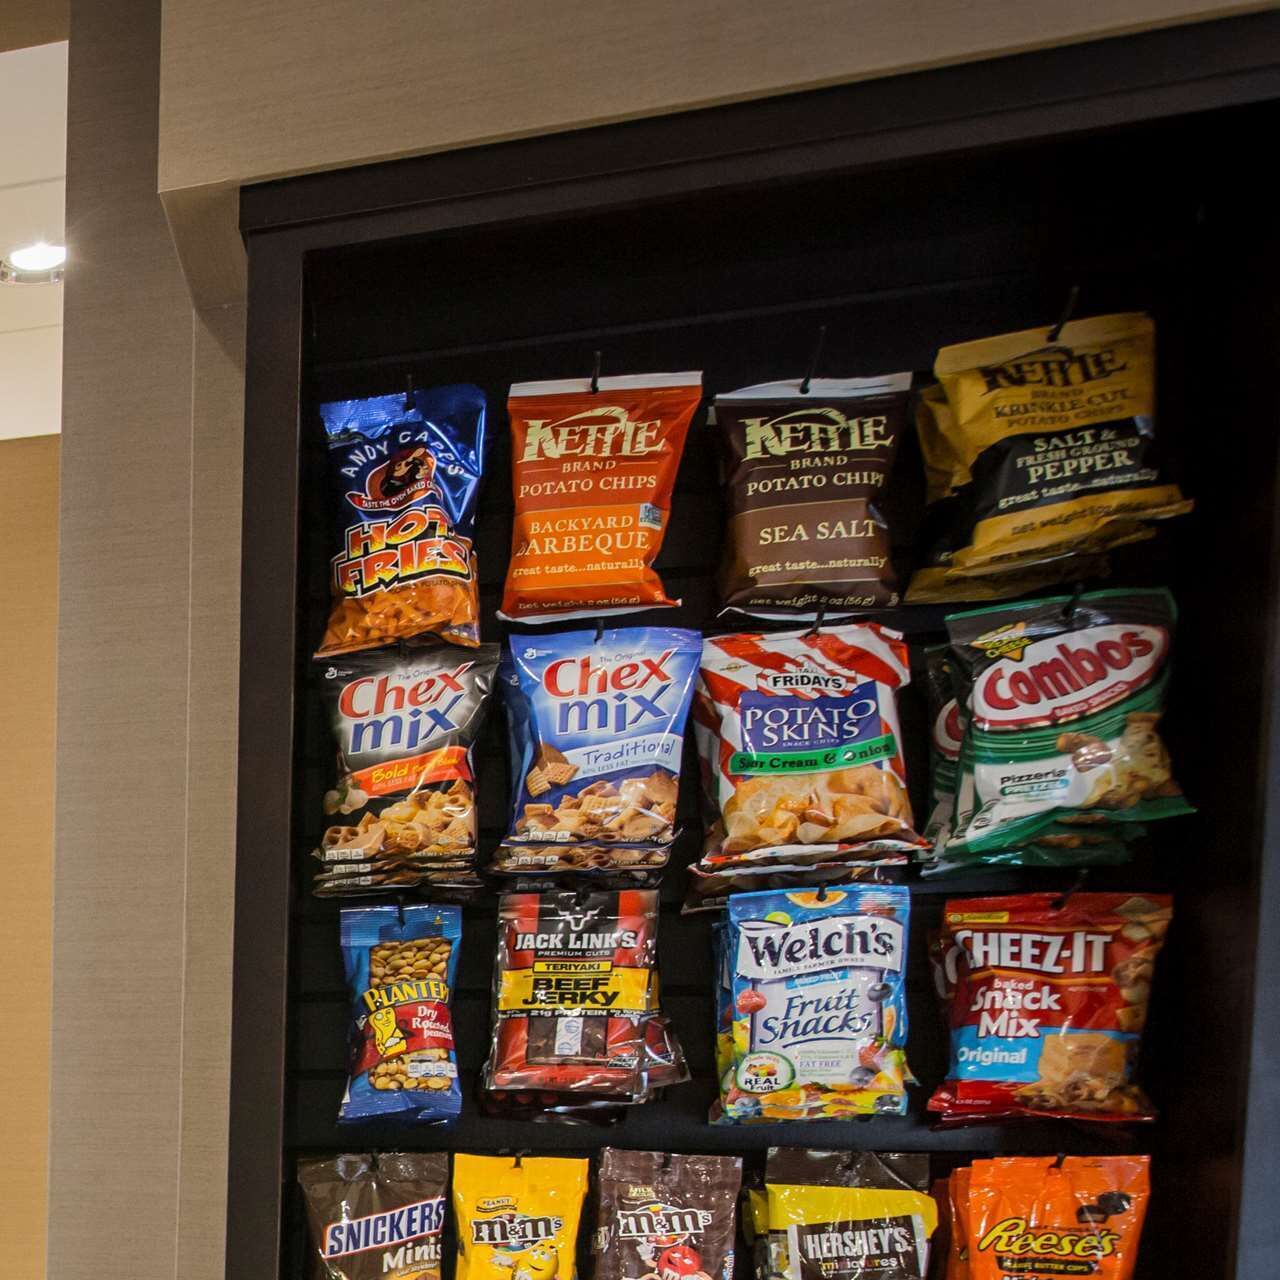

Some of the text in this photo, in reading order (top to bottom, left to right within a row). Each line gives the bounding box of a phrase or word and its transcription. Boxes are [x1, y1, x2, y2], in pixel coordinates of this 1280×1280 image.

[1034, 429, 1118, 452] SALT &
[342, 431, 464, 478] ANDY CAPPS
[562, 460, 617, 473] BRAND
[790, 455, 848, 470] BRAND
[1016, 450, 1068, 468] FRESH
[1028, 450, 1135, 485] PEPPER
[519, 475, 657, 498] POTATO CHIPS
[746, 474, 827, 496] POTATO
[998, 490, 1040, 509] great
[348, 508, 451, 559] HOT
[530, 515, 634, 534] BACKYARD
[759, 519, 877, 545] SEA SALT
[337, 537, 471, 594] FRIES
[748, 562, 782, 577] great
[543, 648, 679, 698] Chex
[983, 631, 1154, 711] Combos
[339, 661, 476, 720] Chex
[556, 682, 675, 735] mix
[744, 699, 877, 730] POTATO
[348, 693, 464, 754] mix
[762, 719, 860, 747] SKINS
[583, 739, 676, 765] Traditional
[739, 743, 890, 770] Sour Cream & Onion
[372, 765, 409, 783] Bold
[1000, 768, 1069, 785] Pizzeria
[515, 931, 636, 950] JACK LINK'S
[745, 923, 894, 968] Welch's
[954, 929, 1113, 975] CHEEZ-IT
[545, 963, 600, 971] TERIYAKI
[532, 977, 610, 991] BEEF
[993, 977, 1034, 992] baked
[522, 991, 620, 1006] JERKY
[784, 988, 860, 1022] Fruit
[970, 985, 1062, 1012] Snack
[417, 1005, 438, 1019] Dry
[530, 1009, 553, 1017] 21g
[555, 1009, 607, 1017] PROTEIN
[977, 1010, 1042, 1039] Mix
[760, 1009, 873, 1045] Snacks
[957, 1047, 1027, 1066] Original
[744, 1077, 781, 1086] REAL
[749, 1084, 776, 1092] Fruit
[482, 1198, 511, 1207] PEANUT
[329, 1199, 447, 1257] SNICKERS
[978, 1217, 1121, 1257] Reese's
[805, 1227, 909, 1260] HERSHEY'S
